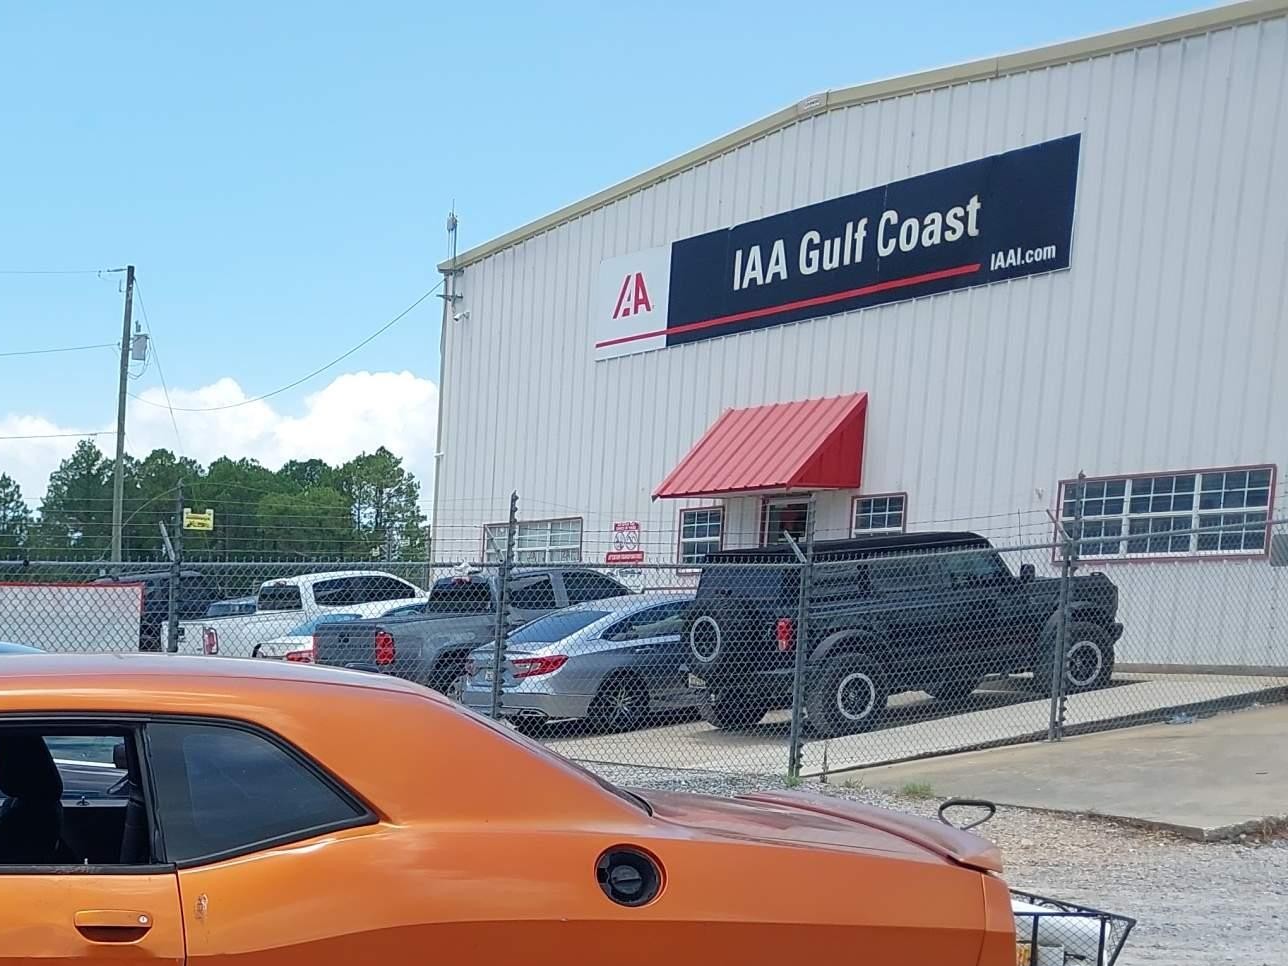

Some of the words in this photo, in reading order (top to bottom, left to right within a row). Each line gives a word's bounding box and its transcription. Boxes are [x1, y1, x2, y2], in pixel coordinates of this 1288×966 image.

[733, 239, 788, 291] IAA
[799, 217, 868, 275] Gulf
[877, 194, 981, 257] Coast
[990, 245, 1056, 271] IAAI.com
